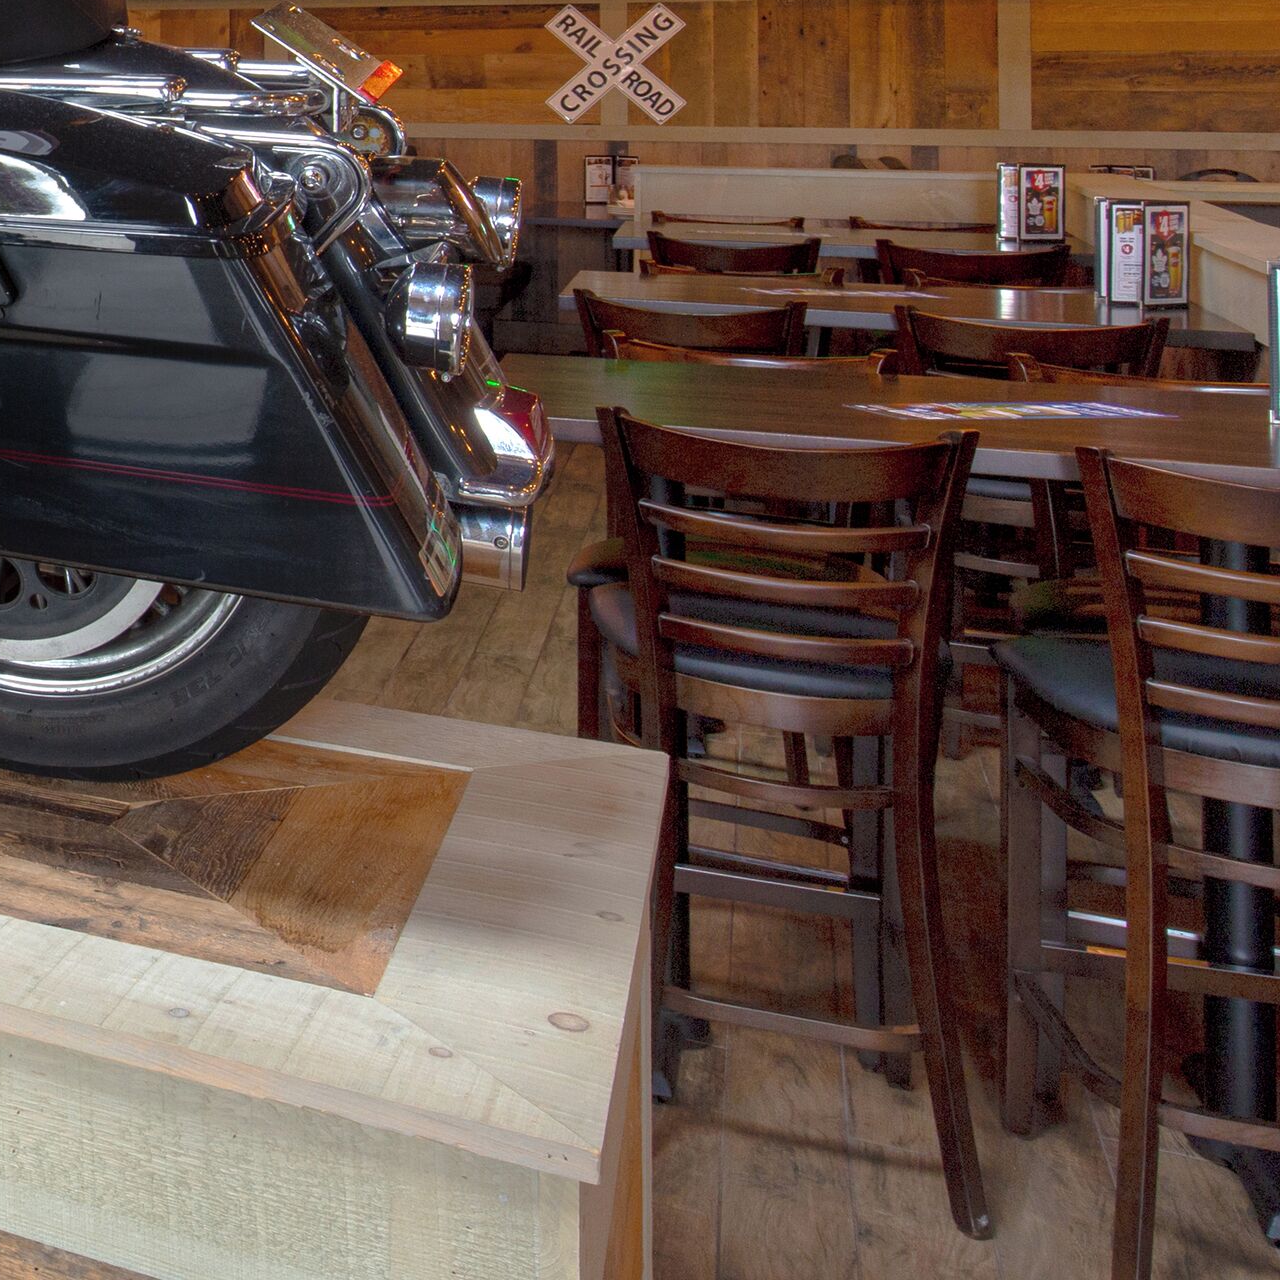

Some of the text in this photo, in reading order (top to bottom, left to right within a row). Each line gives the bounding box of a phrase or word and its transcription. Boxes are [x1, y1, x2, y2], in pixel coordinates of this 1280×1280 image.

[554, 13, 676, 116] RAIL ROAD
[559, 11, 676, 113] CROSSING
